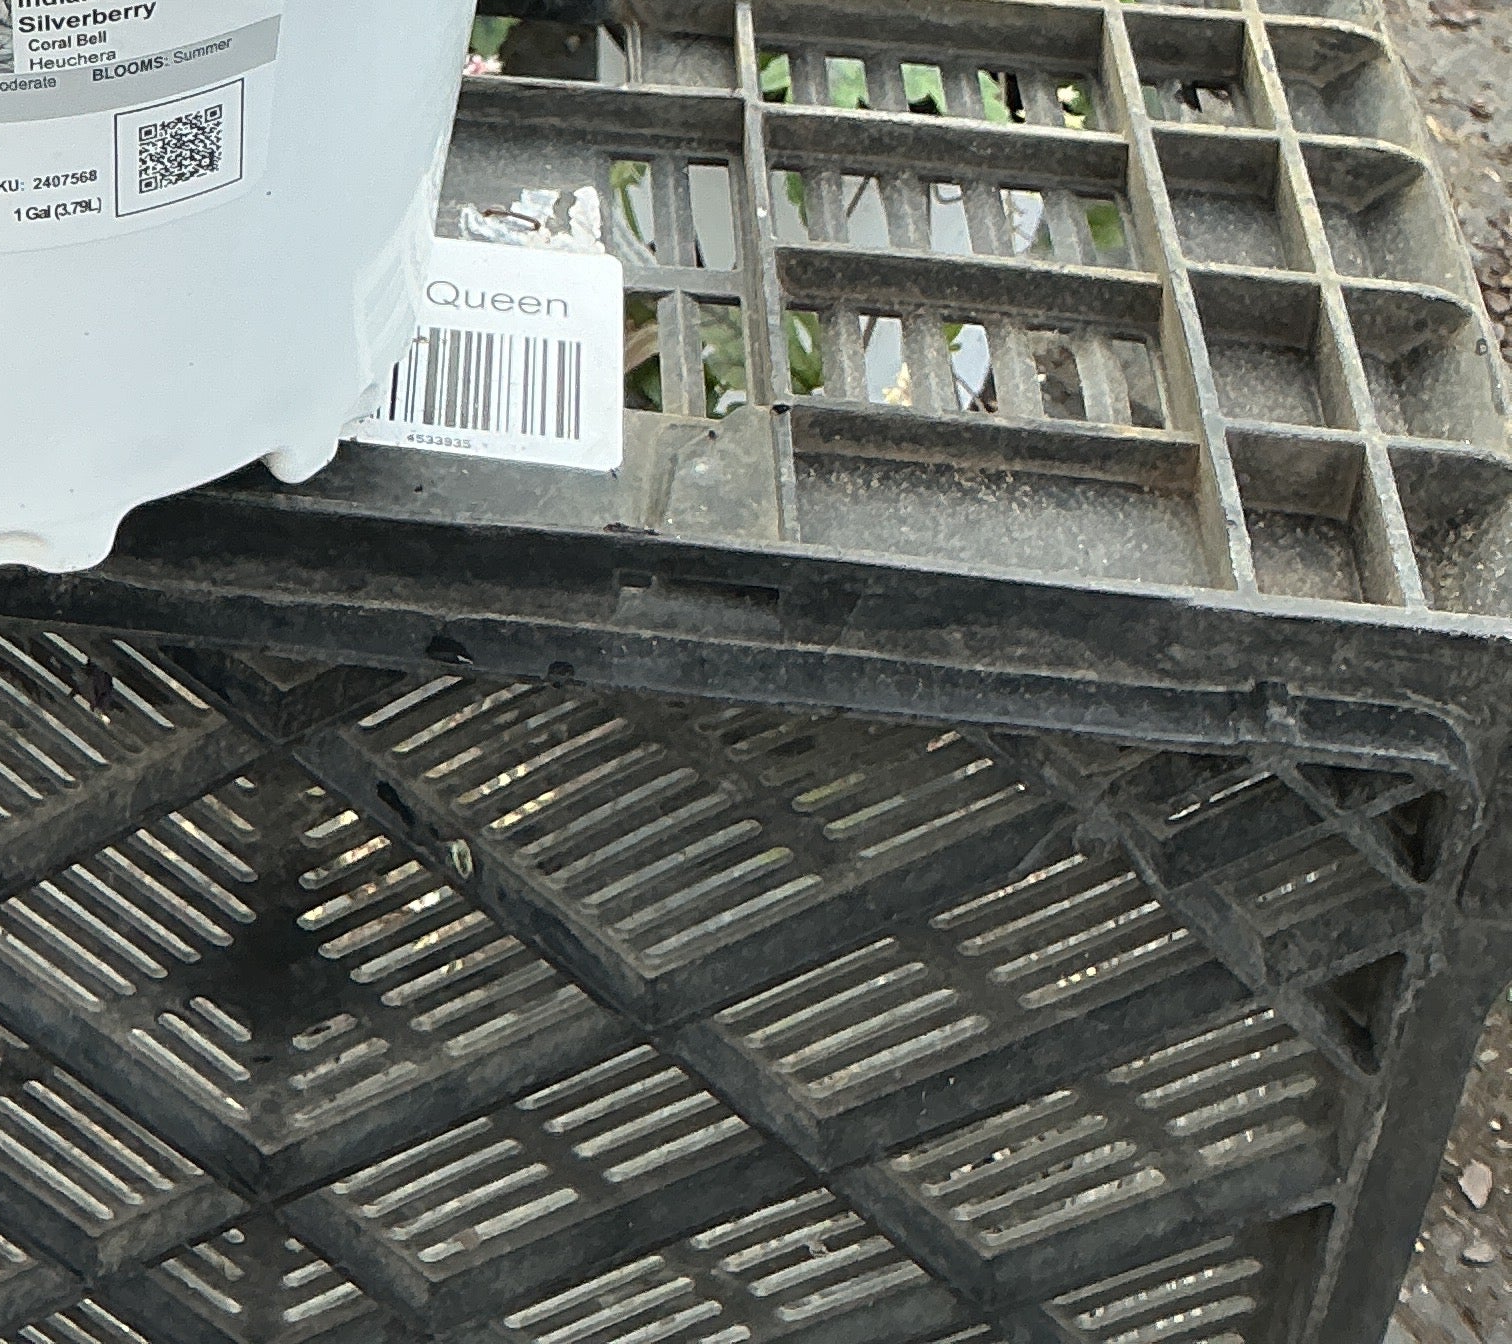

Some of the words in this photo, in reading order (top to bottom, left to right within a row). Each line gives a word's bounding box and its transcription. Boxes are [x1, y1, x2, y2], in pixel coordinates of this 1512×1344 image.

[18, 2, 157, 33] Silverberry
[28, 36, 72, 53] Coral
[76, 31, 107, 47] Bell
[29, 50, 117, 71] Heuchera
[92, 56, 170, 82] BLOOMS:
[173, 38, 233, 64] Summer
[32, 170, 98, 190] 2407568
[14, 209, 22, 221] 1
[25, 205, 51, 221] Gal
[54, 197, 102, 220] (3.79L)
[426, 280, 569, 318] Queen
